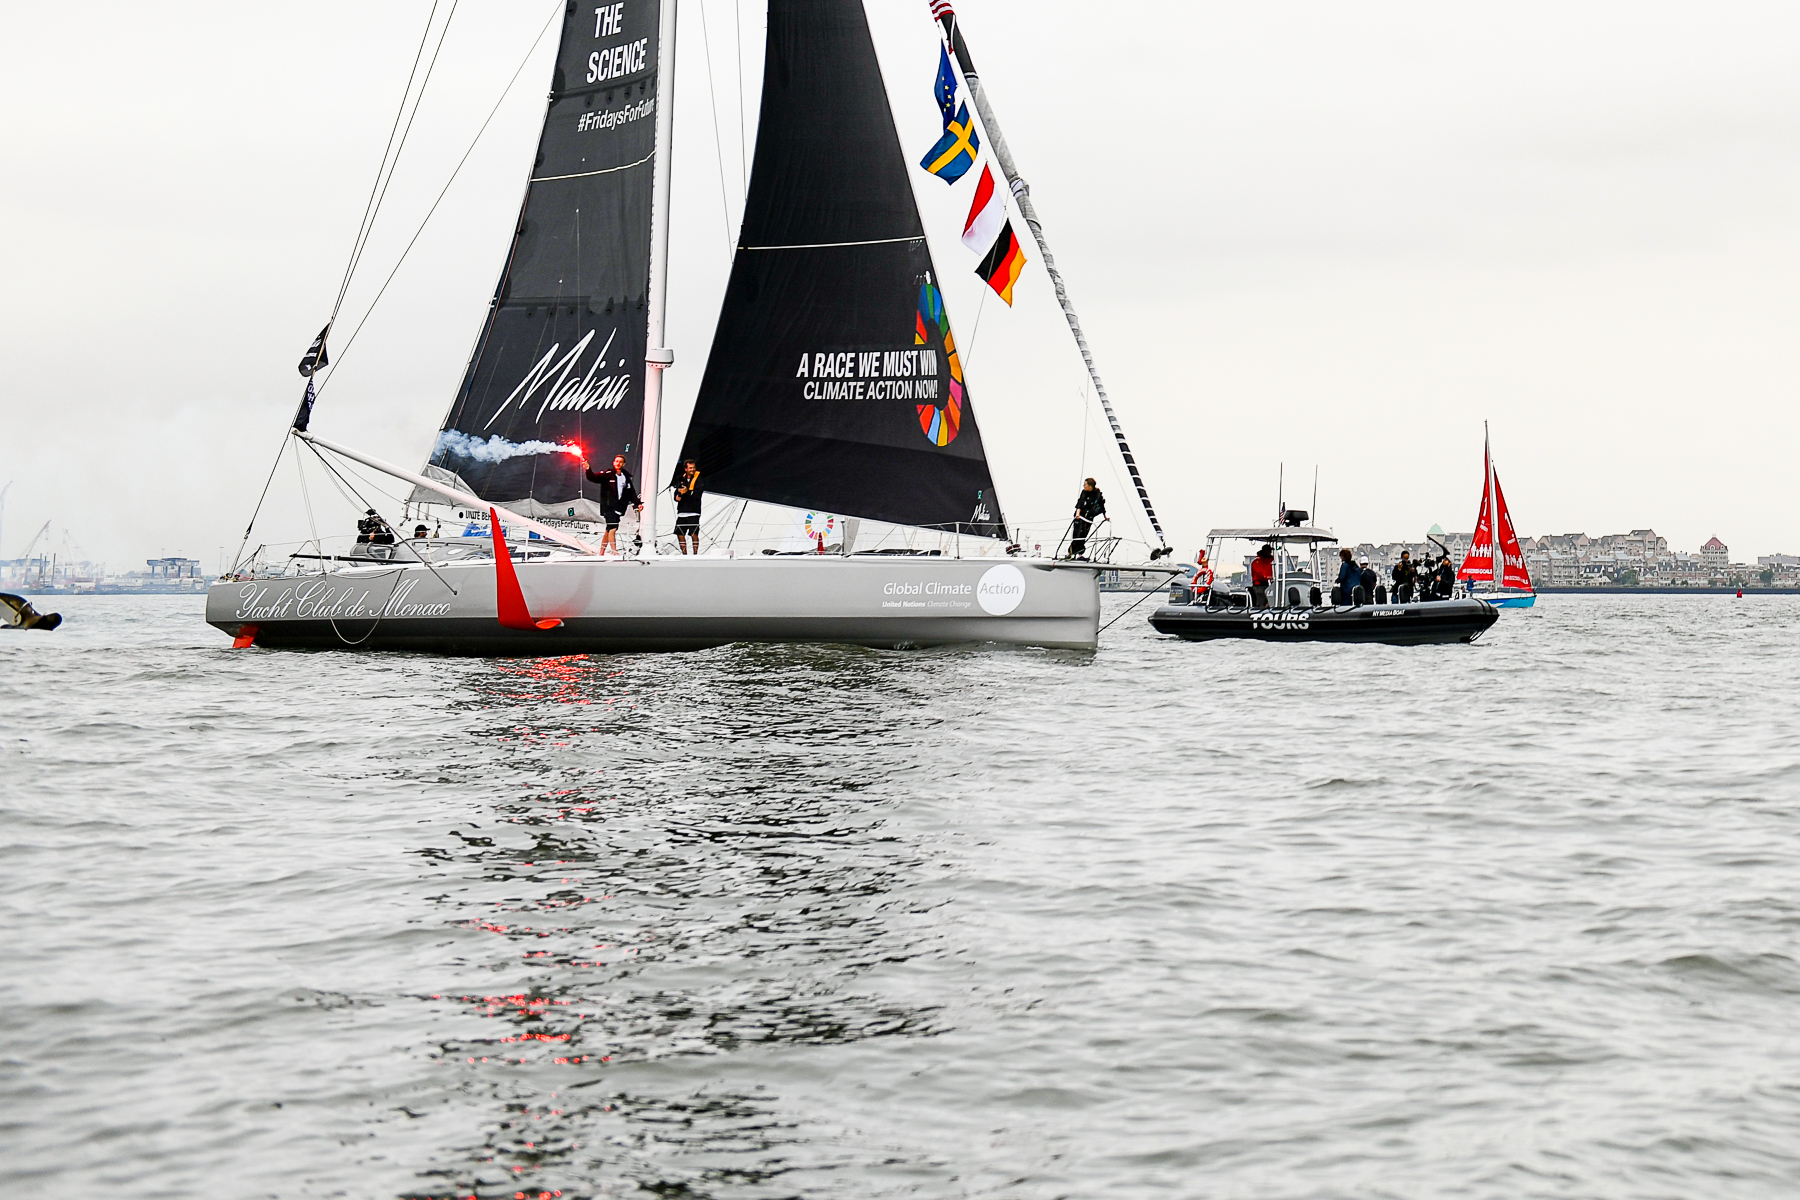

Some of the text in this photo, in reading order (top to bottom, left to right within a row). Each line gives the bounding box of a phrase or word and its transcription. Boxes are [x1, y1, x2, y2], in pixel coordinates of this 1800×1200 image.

[594, 2, 624, 38] THE
[586, 38, 648, 84] SCIENCE
[577, 98, 655, 132] #FridaysForFuture
[795, 350, 937, 378] A RACE WE MUST WIN
[483, 327, 631, 431] Malizia
[803, 379, 938, 400] CLIMATE ACTION NOW!
[465, 510, 481, 520] UNITE
[235, 578, 451, 619] Yacht Club de Monaco
[883, 582, 1019, 595] Global Climate Action
[950, 601, 972, 609] Change
[1250, 613, 1310, 630] TOURS
